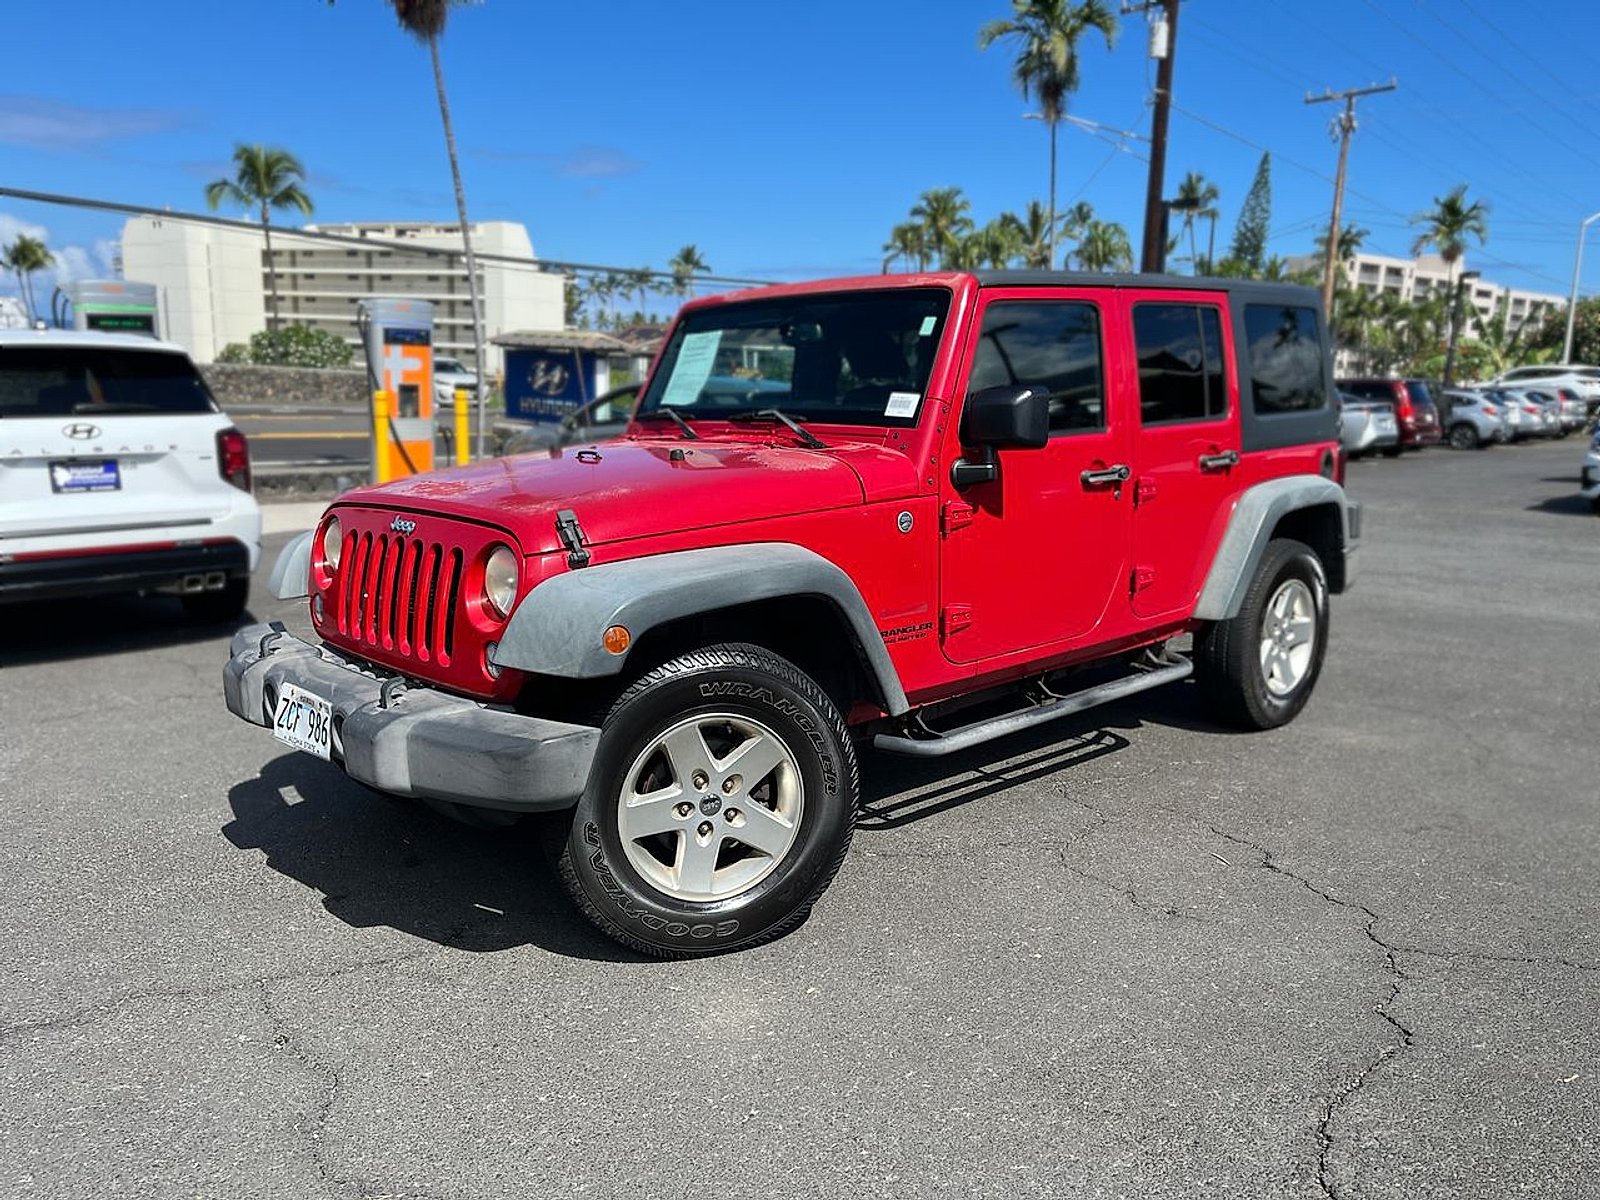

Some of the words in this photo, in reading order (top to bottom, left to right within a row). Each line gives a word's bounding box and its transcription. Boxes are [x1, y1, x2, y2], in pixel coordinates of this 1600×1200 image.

[9, 444, 178, 456] ALISADE
[391, 515, 416, 537] Jeep
[880, 622, 933, 639] RANGLER
[277, 697, 303, 733] ZCF
[307, 709, 329, 747] 986
[699, 681, 842, 797] WRANGLER
[583, 821, 740, 938] GOODYEAR
